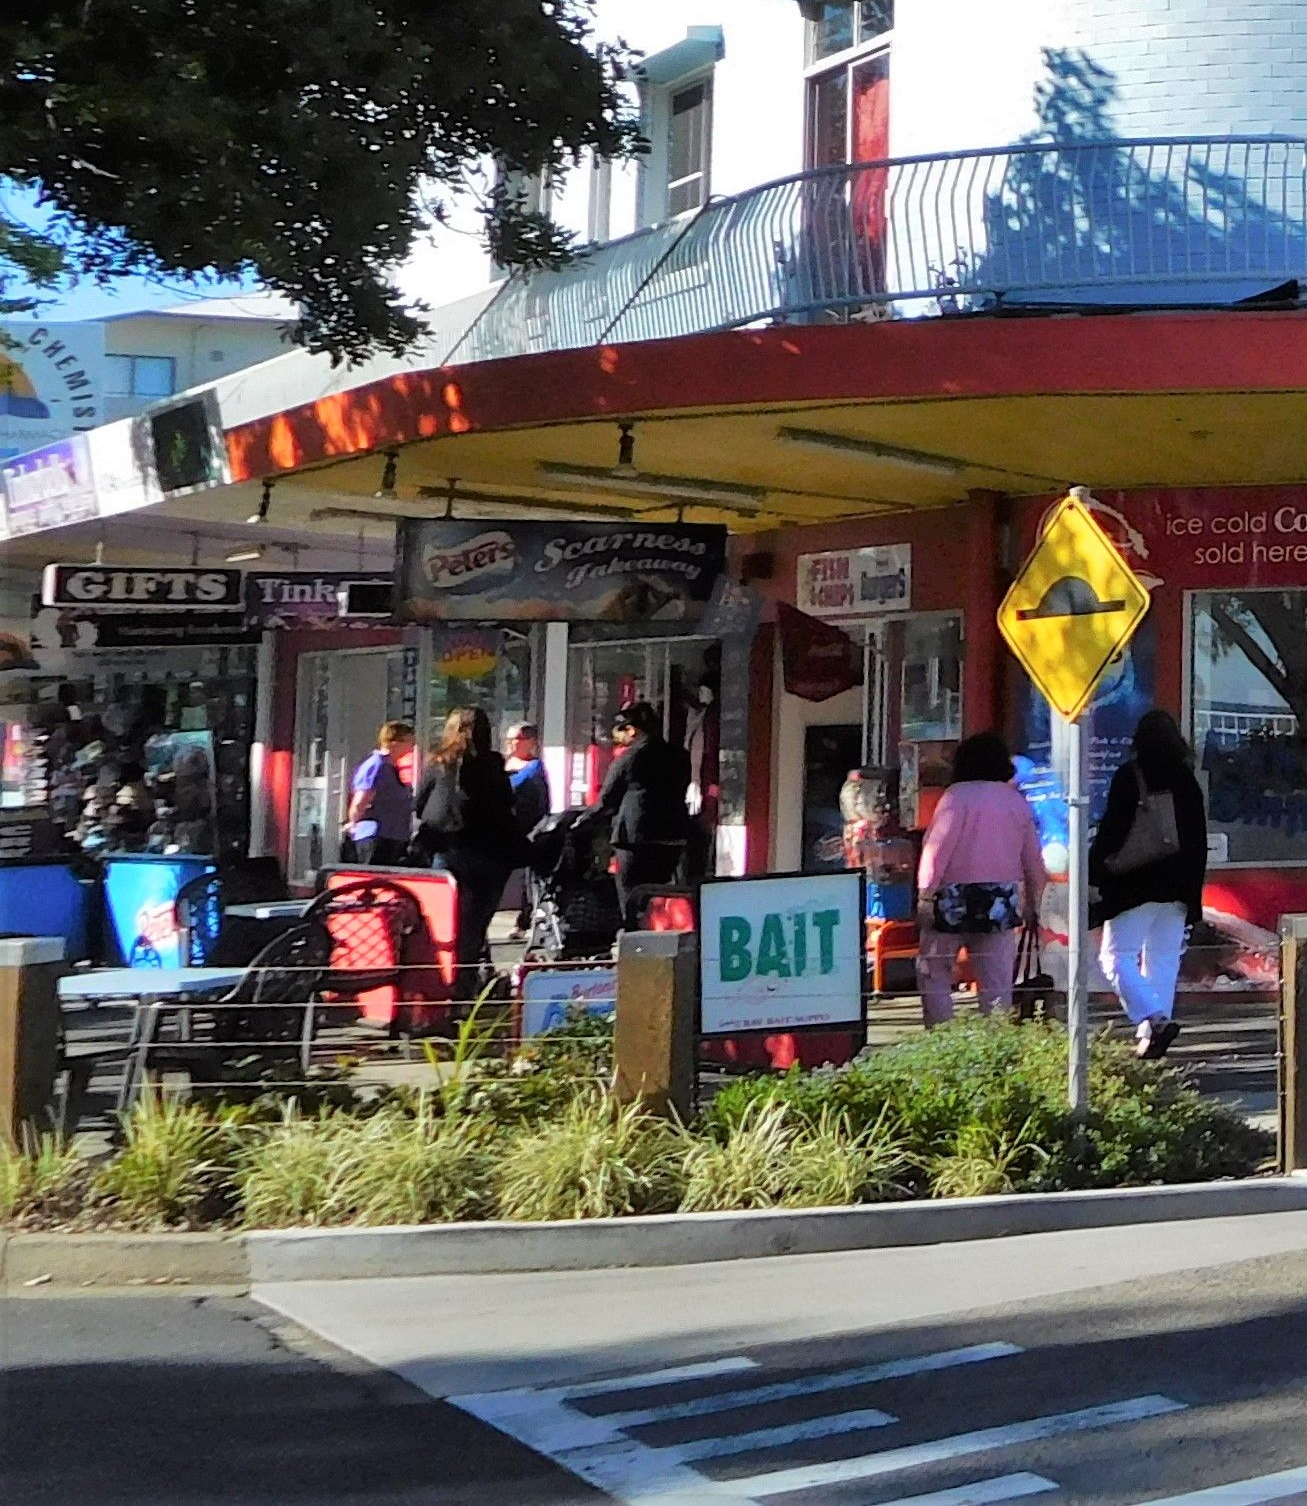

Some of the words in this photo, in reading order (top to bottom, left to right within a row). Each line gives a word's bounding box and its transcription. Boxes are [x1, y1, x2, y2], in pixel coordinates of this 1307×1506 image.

[1166, 514, 1203, 536] ice
[1215, 511, 1267, 534] cold
[533, 531, 706, 573] Scarness
[1194, 545, 1243, 565] sold
[66, 572, 228, 601] GIFTS
[720, 909, 839, 982] BAIT
